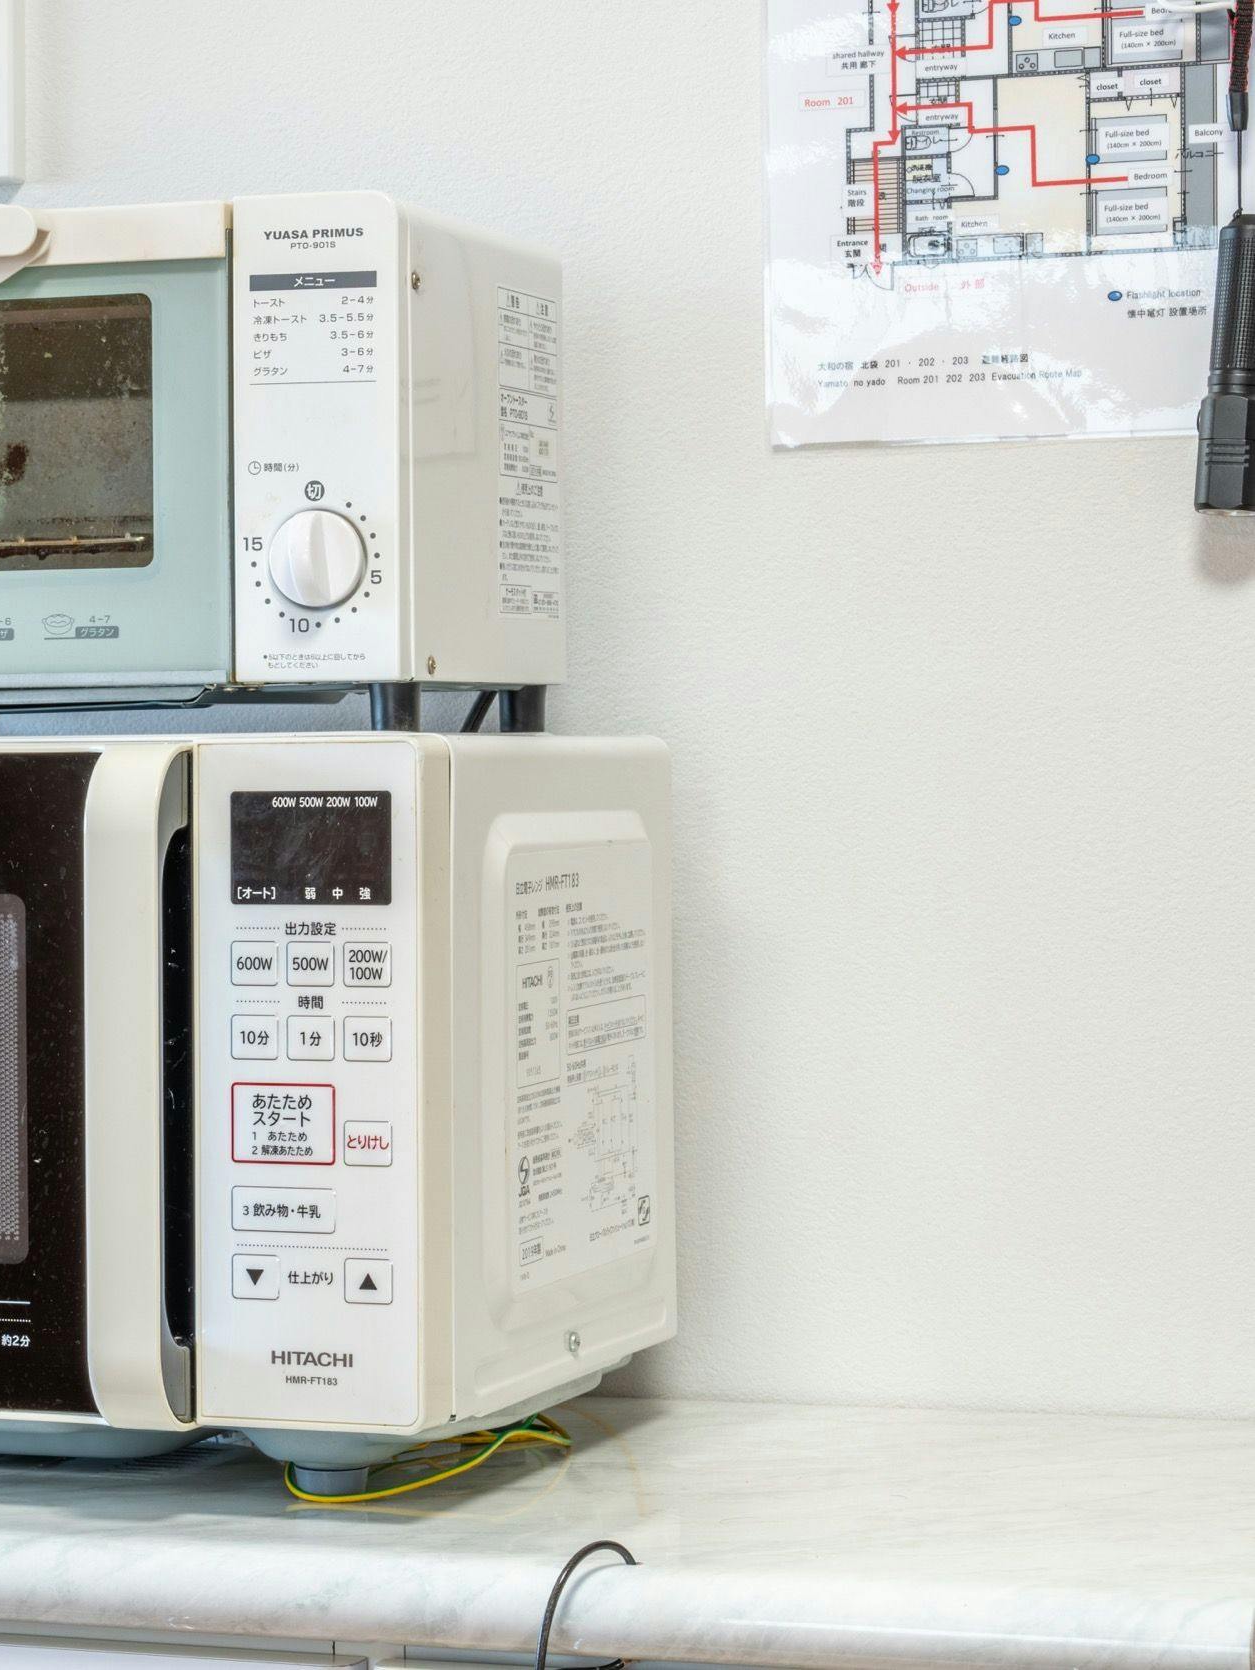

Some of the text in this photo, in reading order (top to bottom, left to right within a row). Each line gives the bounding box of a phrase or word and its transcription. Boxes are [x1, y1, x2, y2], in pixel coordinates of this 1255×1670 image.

[1048, 32, 1076, 40] Kitchen
[1150, 28, 1164, 37] bed
[832, 49, 885, 60] shared hallway
[924, 63, 958, 73] entryway
[1096, 82, 1119, 91] closet
[1139, 77, 1162, 86] closet
[804, 96, 854, 108] Room 201
[925, 112, 959, 123] entryway
[1135, 129, 1150, 137] bed
[1194, 129, 1224, 138] Balcony
[1134, 172, 1168, 180] Bedroom
[847, 189, 867, 197] Stairs
[1135, 202, 1149, 211] bed
[960, 220, 988, 229] Kitchen
[264, 227, 364, 240] YUASA PRIMUS
[290, 241, 336, 250] PTO-901S
[837, 239, 869, 248] Entrance
[294, 276, 335, 288] メニュー
[904, 282, 940, 293] Outside
[1168, 289, 1201, 298] location
[253, 298, 285, 308] トースト
[253, 314, 307, 325] 冷凍トースト
[253, 332, 287, 342] きりもち
[885, 358, 901, 368] 201
[918, 357, 935, 367] 202
[952, 356, 969, 366] 203
[253, 366, 288, 377] グラタン
[866, 378, 886, 388] yado
[897, 375, 921, 385] Room
[923, 375, 939, 383] 201
[946, 374, 963, 383] 202
[969, 373, 986, 382] 203
[991, 371, 1037, 381] Evacuation
[306, 482, 323, 500] 切
[243, 537, 263, 551] 15
[371, 569, 382, 584] 5
[88, 615, 111, 624] 4-7
[289, 618, 310, 633] 10
[272, 796, 378, 808] 600W 500W 200W 100W
[305, 887, 316, 900] 弱
[332, 887, 343, 900] 中
[359, 887, 371, 900] 強
[284, 922, 337, 936] 出力設定
[348, 950, 388, 964] 200W/
[236, 957, 328, 971] 600W 500W
[349, 967, 383, 981] 100W
[298, 995, 324, 1010] 時間
[239, 1031, 383, 1048] 10分 1分 10秒
[252, 1093, 312, 1110] あたため
[252, 1111, 311, 1128] スタート
[267, 1131, 308, 1142] あたため
[347, 1135, 389, 1151] とりけし
[242, 1204, 321, 1219] 3 飲み物・牛乳
[288, 1271, 334, 1286] 仕上がり
[270, 1350, 354, 1368] HITACHI
[285, 1376, 338, 1387] HMR-FT183
